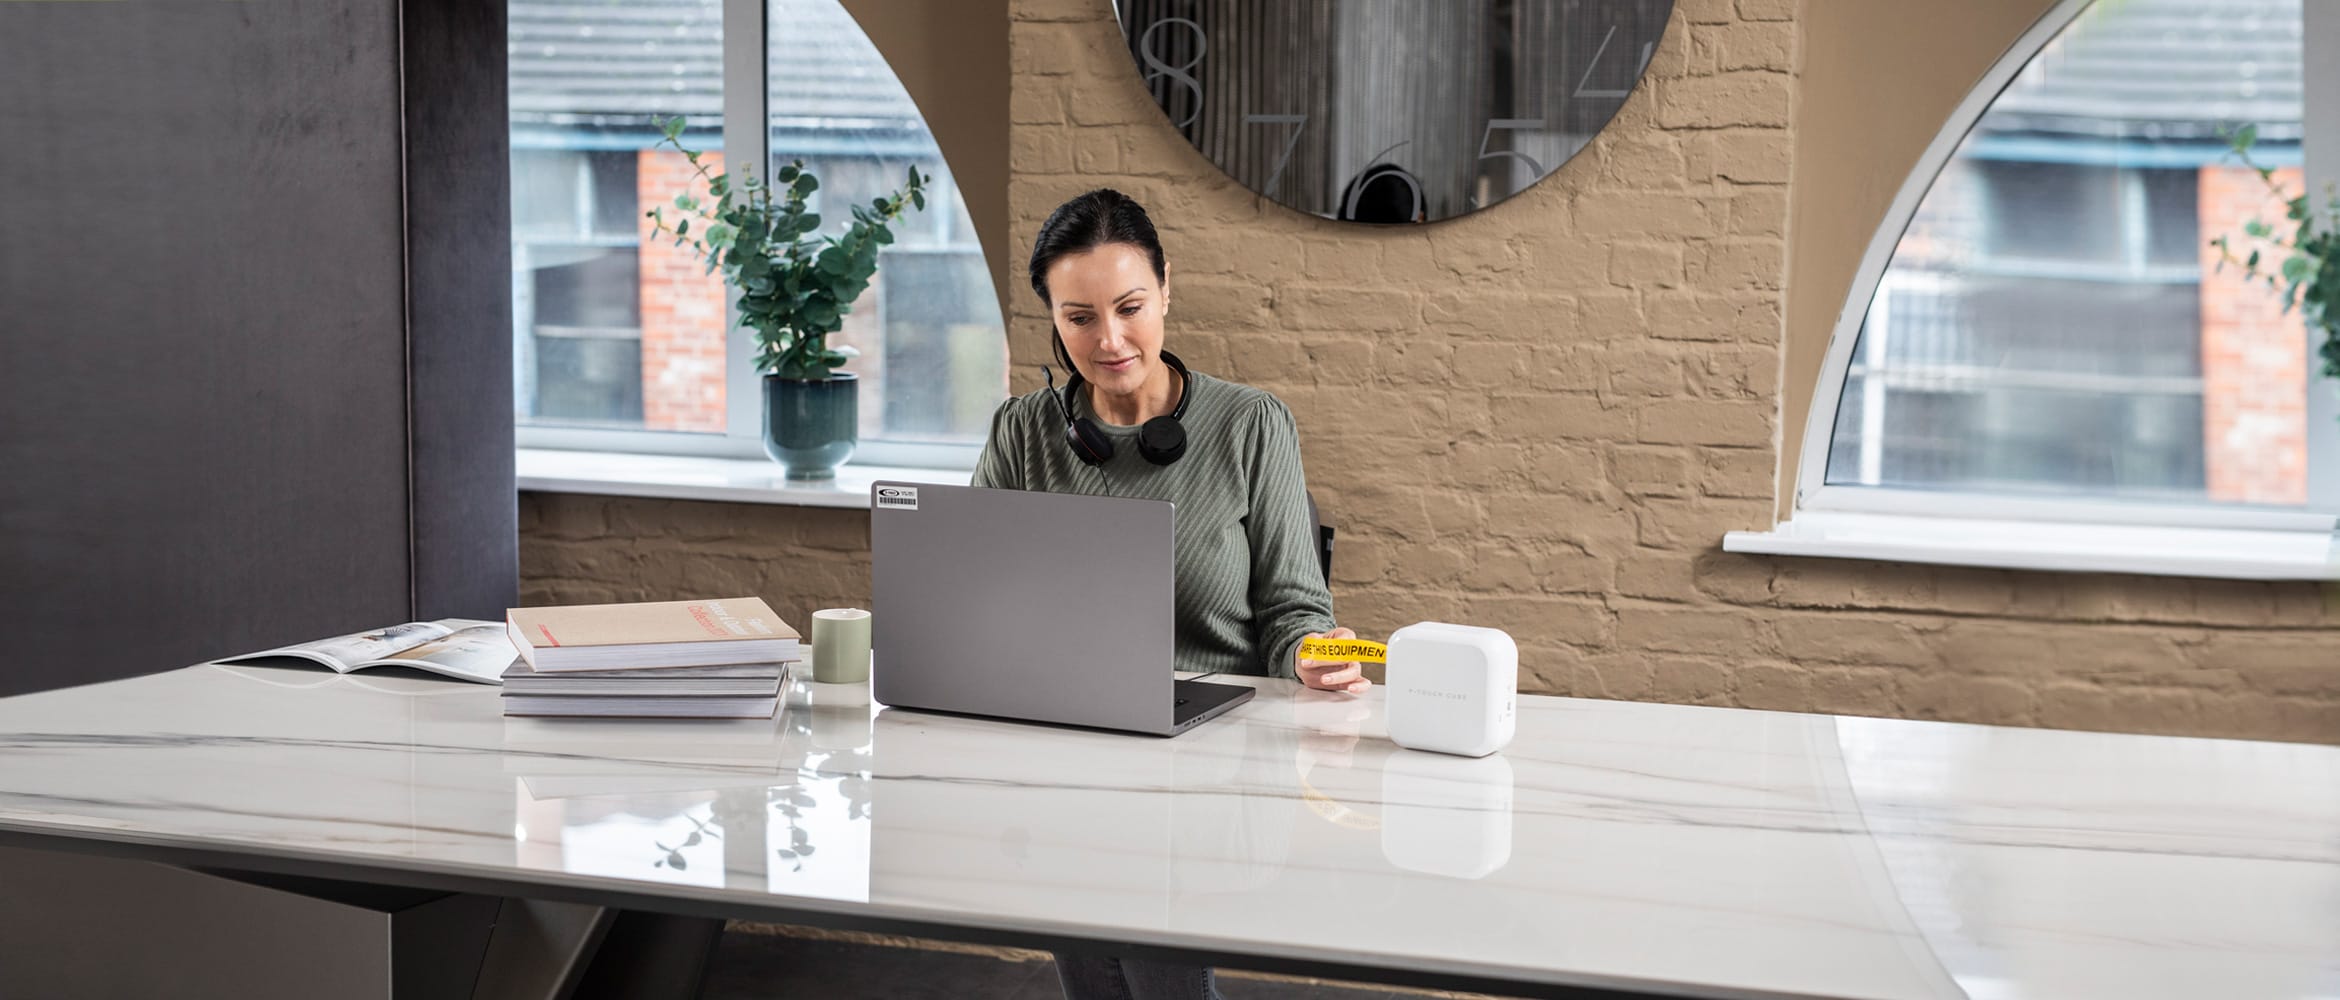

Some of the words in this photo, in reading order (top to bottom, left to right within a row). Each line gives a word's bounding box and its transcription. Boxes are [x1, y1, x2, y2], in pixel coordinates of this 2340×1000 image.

[1141, 17, 1207, 128] 8
[1573, 25, 1653, 98] 4
[1242, 115, 1308, 198] 7
[1346, 140, 1422, 221] 6
[1473, 119, 1545, 206] 5
[1313, 644, 1327, 656] THIS
